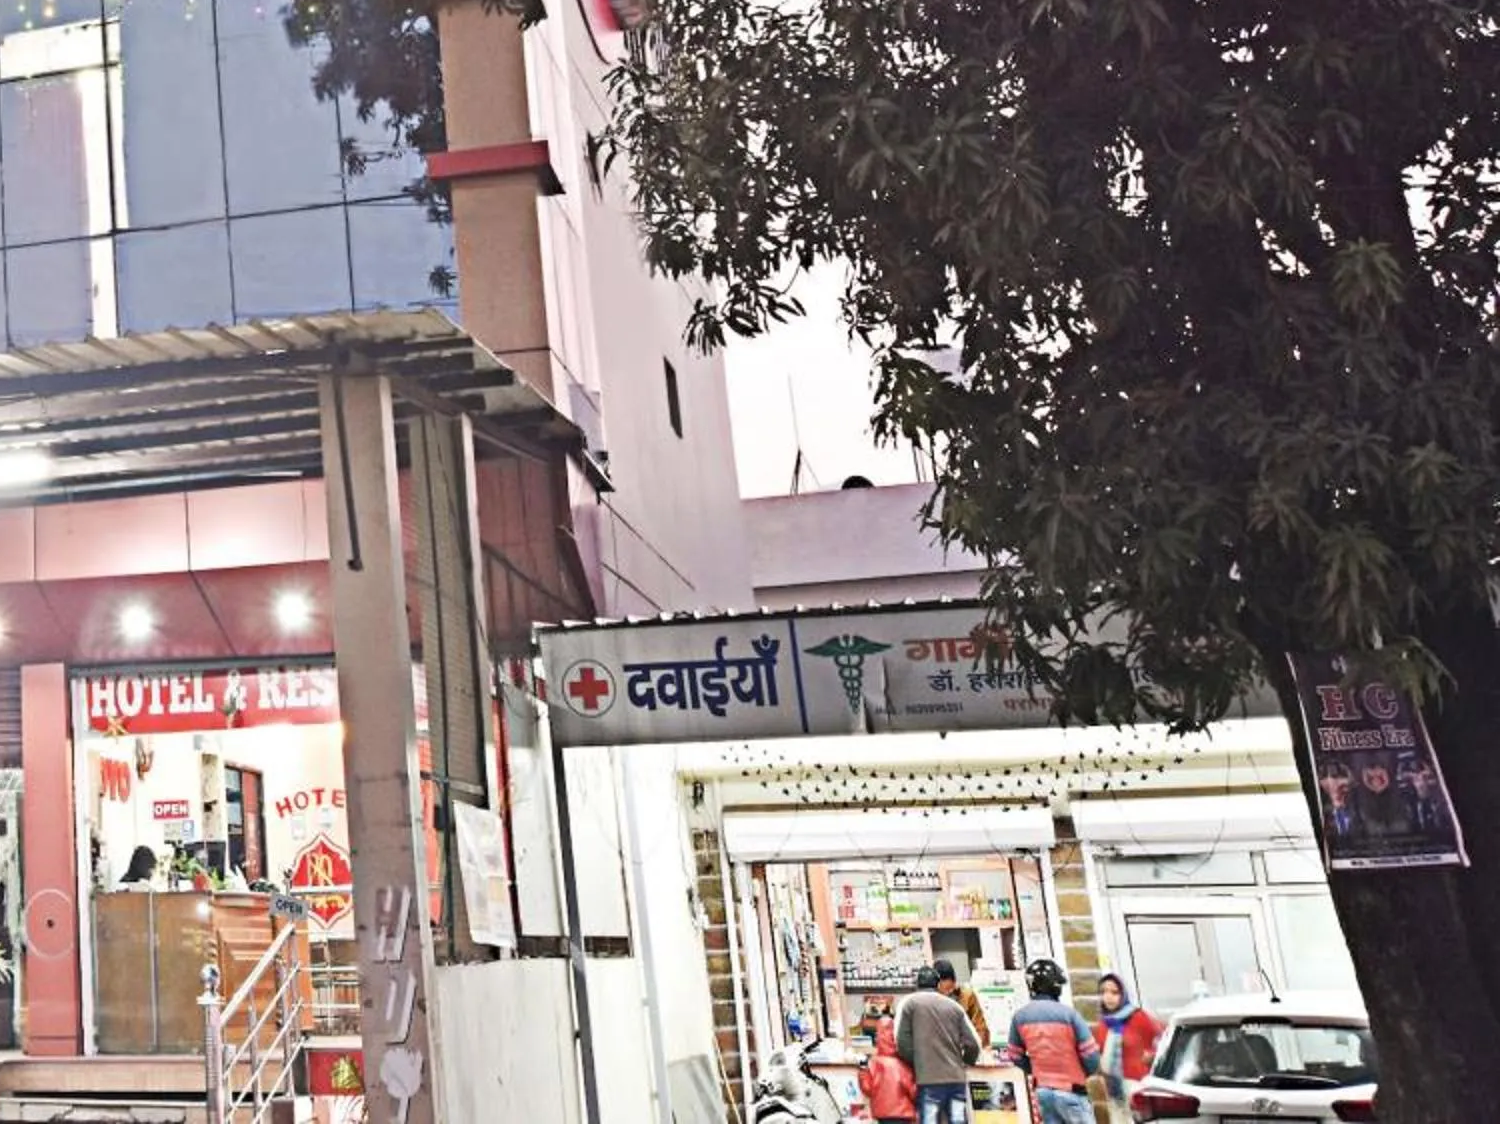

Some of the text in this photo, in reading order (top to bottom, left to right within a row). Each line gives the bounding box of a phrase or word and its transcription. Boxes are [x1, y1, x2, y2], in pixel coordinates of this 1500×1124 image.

[91, 673, 214, 717] HOTEL
[155, 803, 188, 816] OPEN
[275, 898, 304, 915] OPEN
